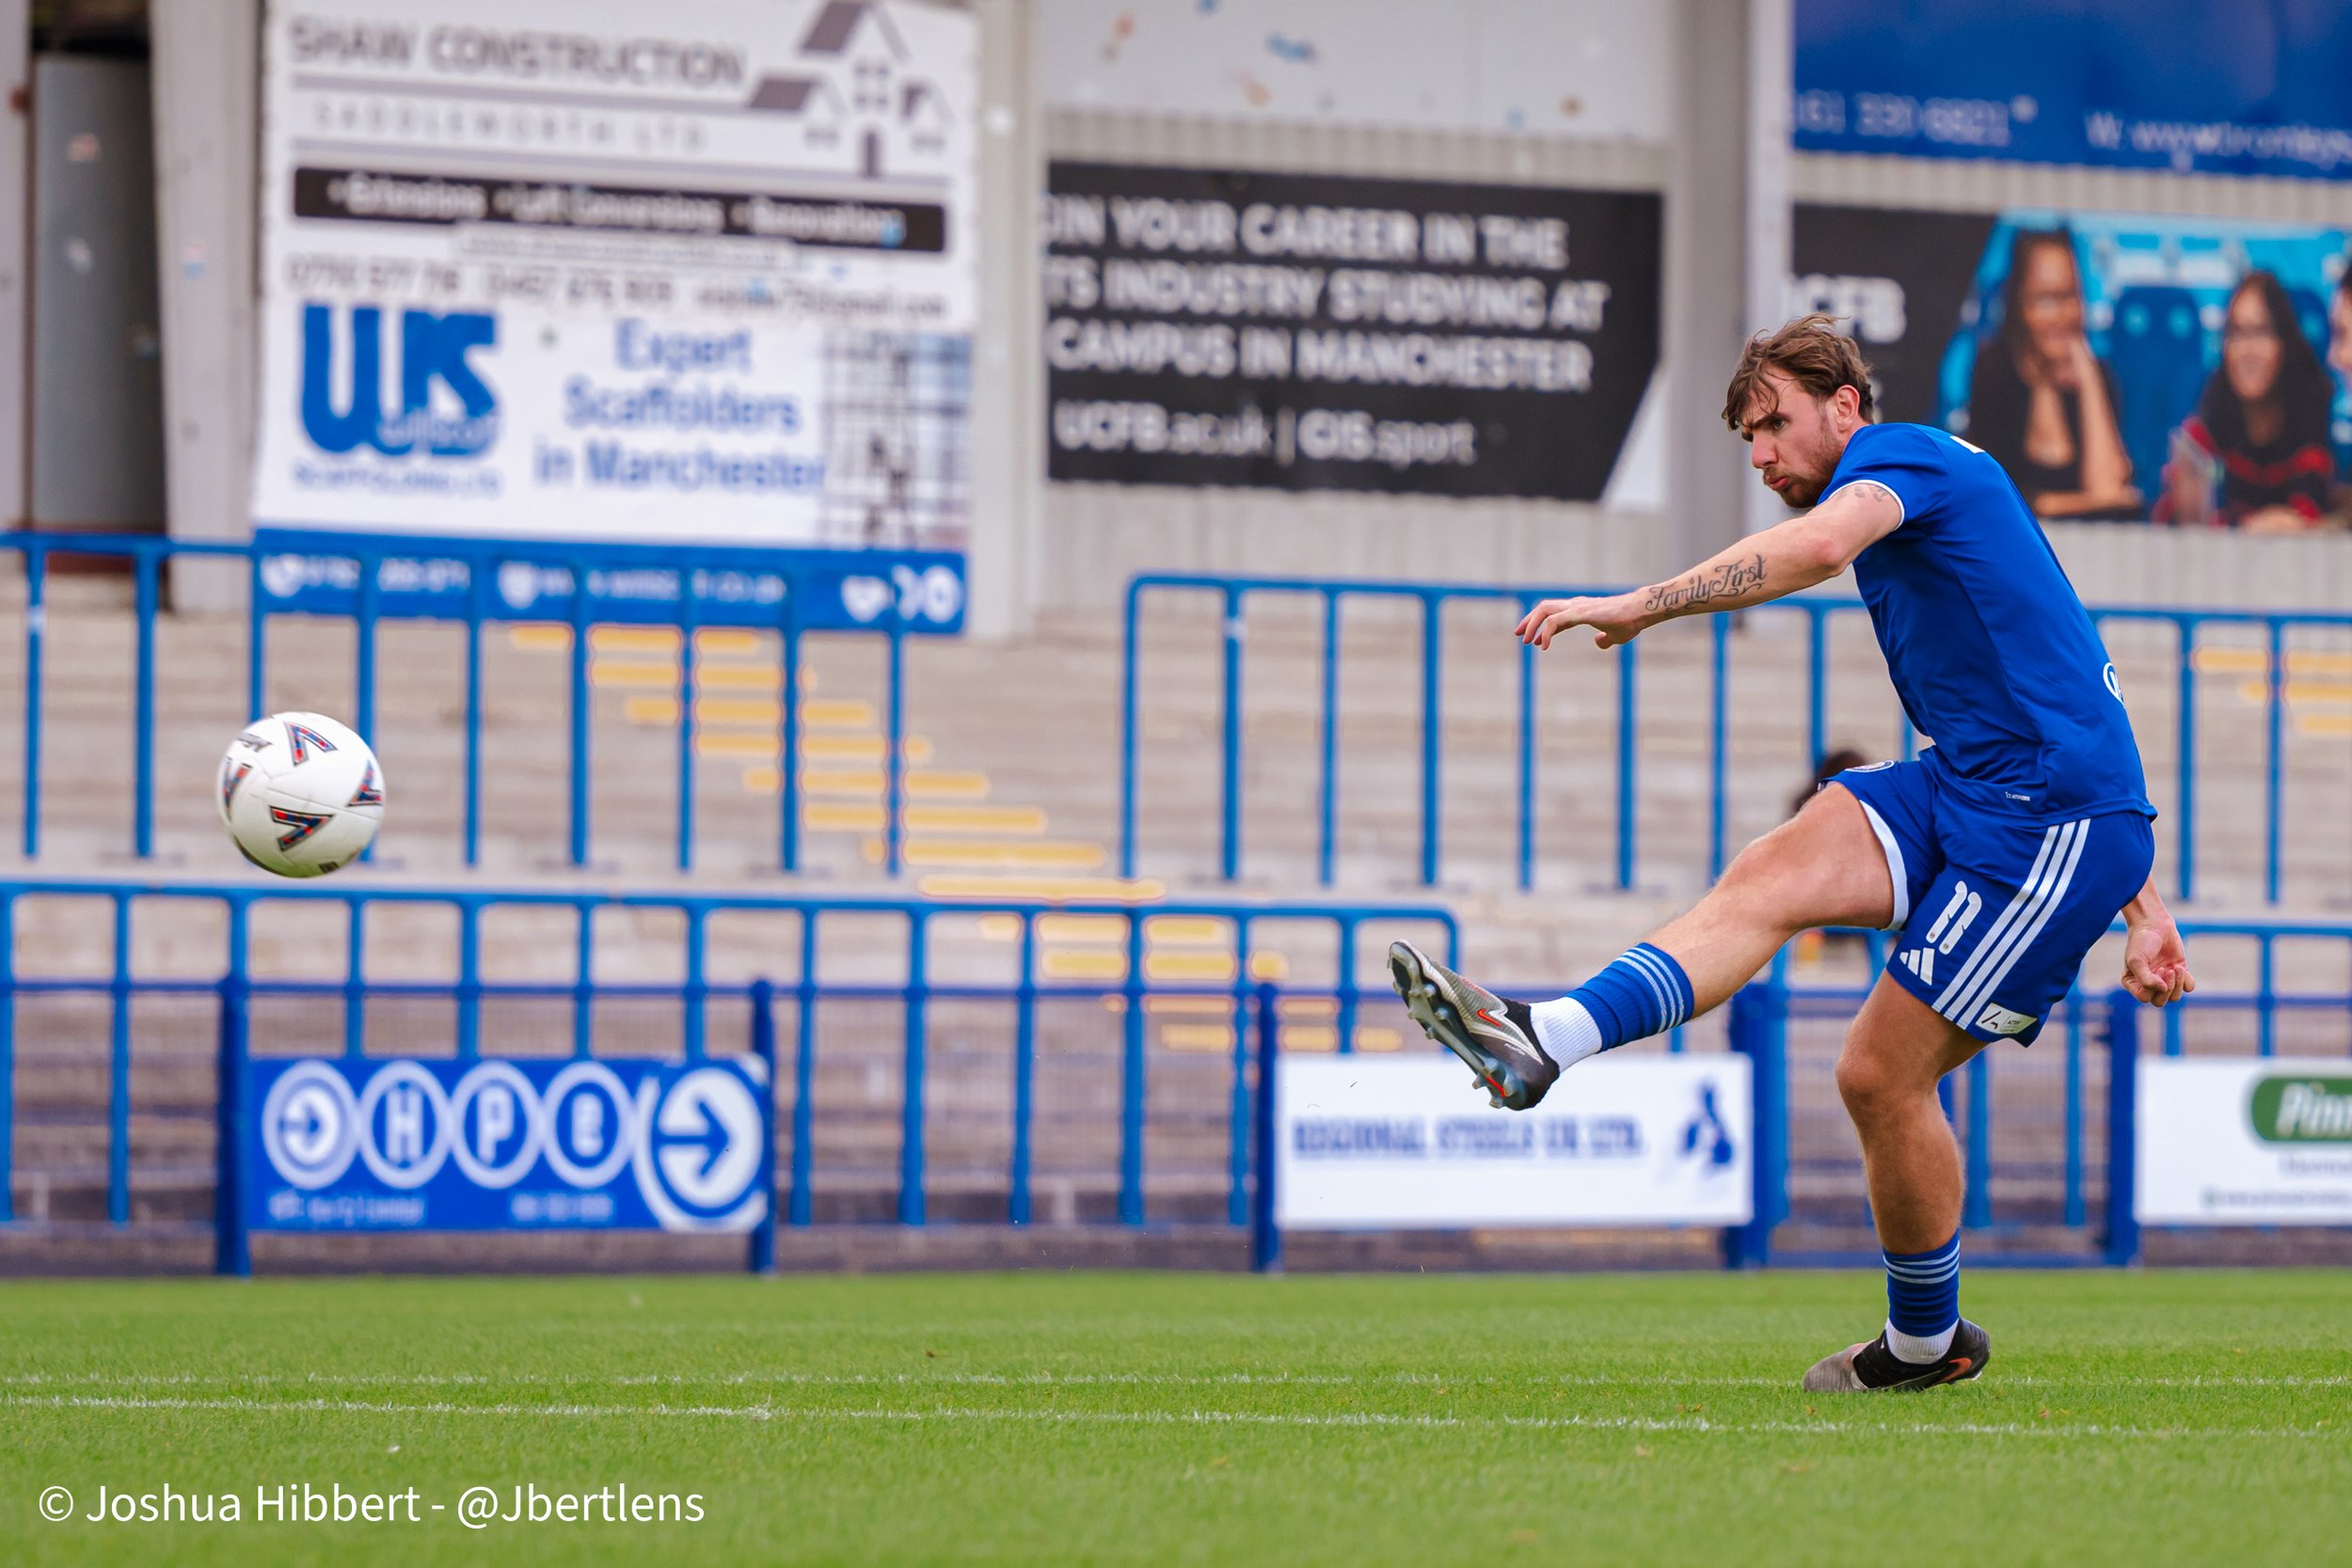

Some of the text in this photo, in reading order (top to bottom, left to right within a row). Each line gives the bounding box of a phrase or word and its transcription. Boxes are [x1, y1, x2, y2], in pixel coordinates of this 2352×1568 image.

[288, 16, 746, 87] SHAW CONSTRUCTION
[1109, 196, 1237, 252] YOUR
[1241, 203, 1419, 262] CAREER
[1423, 213, 1476, 264] IN
[1480, 215, 1569, 270] THE
[1103, 259, 1327, 317] INDUSTRY
[1327, 268, 1547, 330] STUDYING
[1550, 280, 1611, 332] AT
[615, 317, 752, 378] Expert
[1046, 317, 1593, 391] CAMPUS IN MANCHESTER
[564, 373, 802, 435] Scaffolders
[532, 435, 825, 496] in Manchester
[1645, 554, 1768, 611] Family First
[1926, 880, 1982, 955] 11
